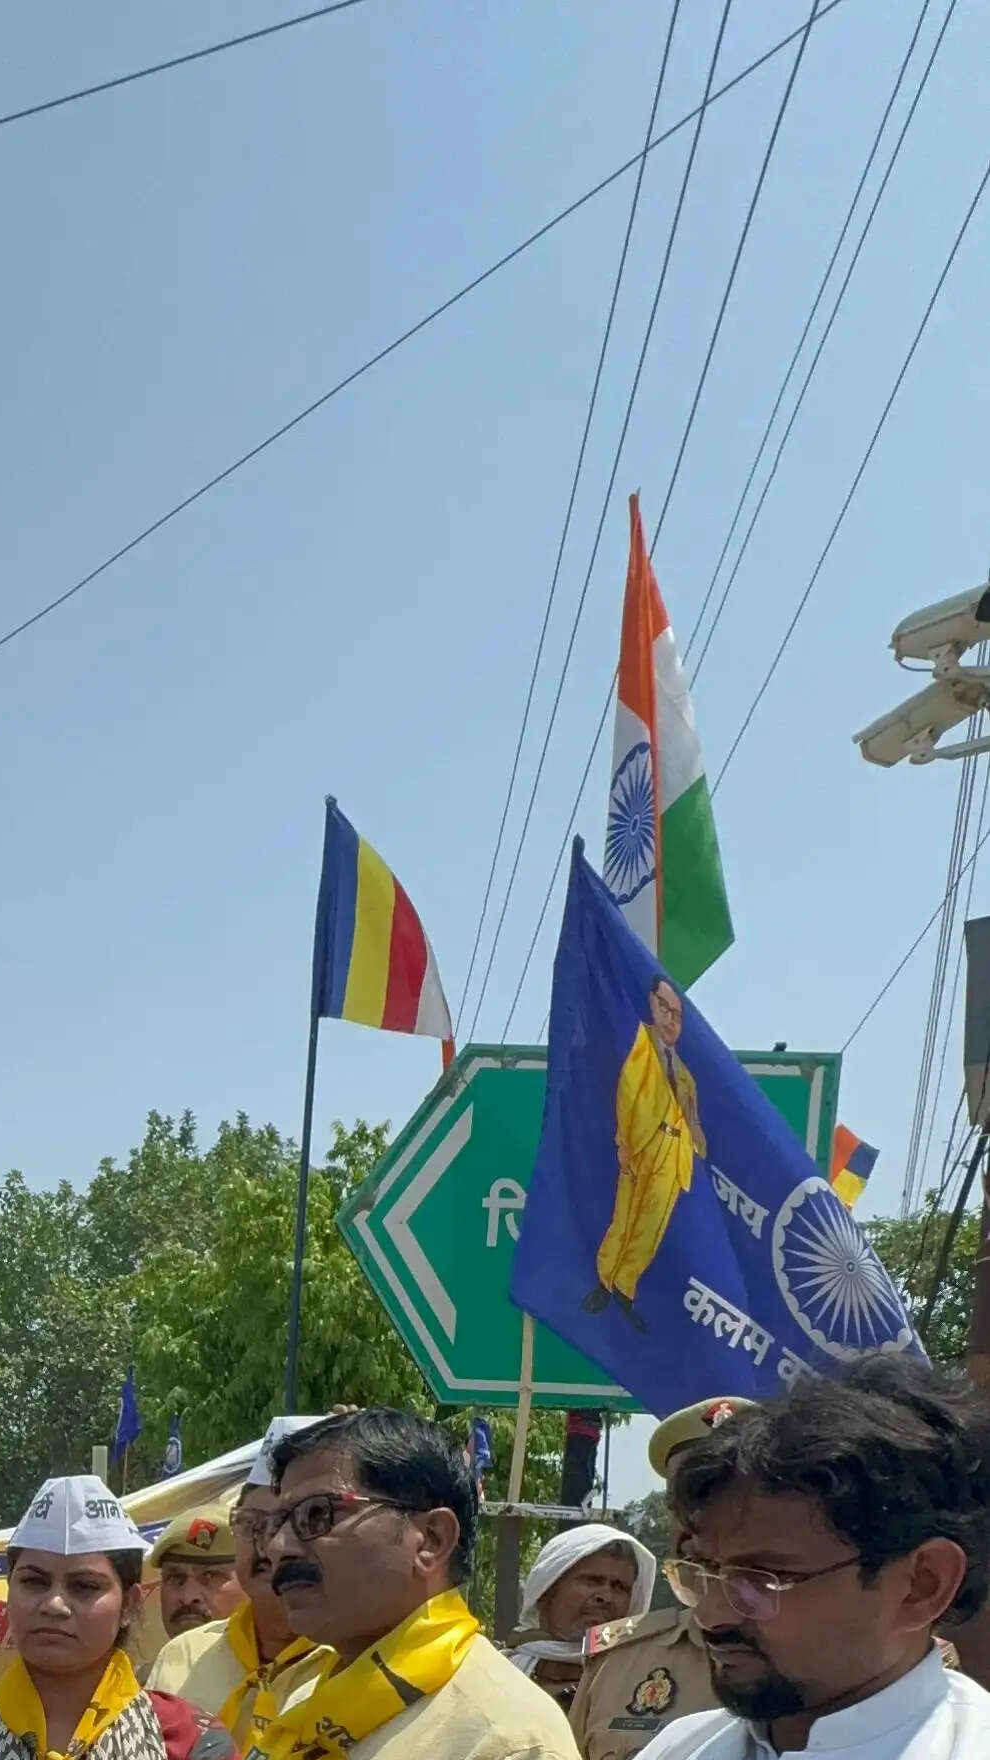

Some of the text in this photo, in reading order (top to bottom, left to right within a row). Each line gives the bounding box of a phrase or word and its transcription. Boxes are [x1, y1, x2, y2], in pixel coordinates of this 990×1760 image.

[711, 1164, 770, 1240] जय
[683, 1276, 776, 1367] कलम
[85, 1498, 121, 1520] आम
